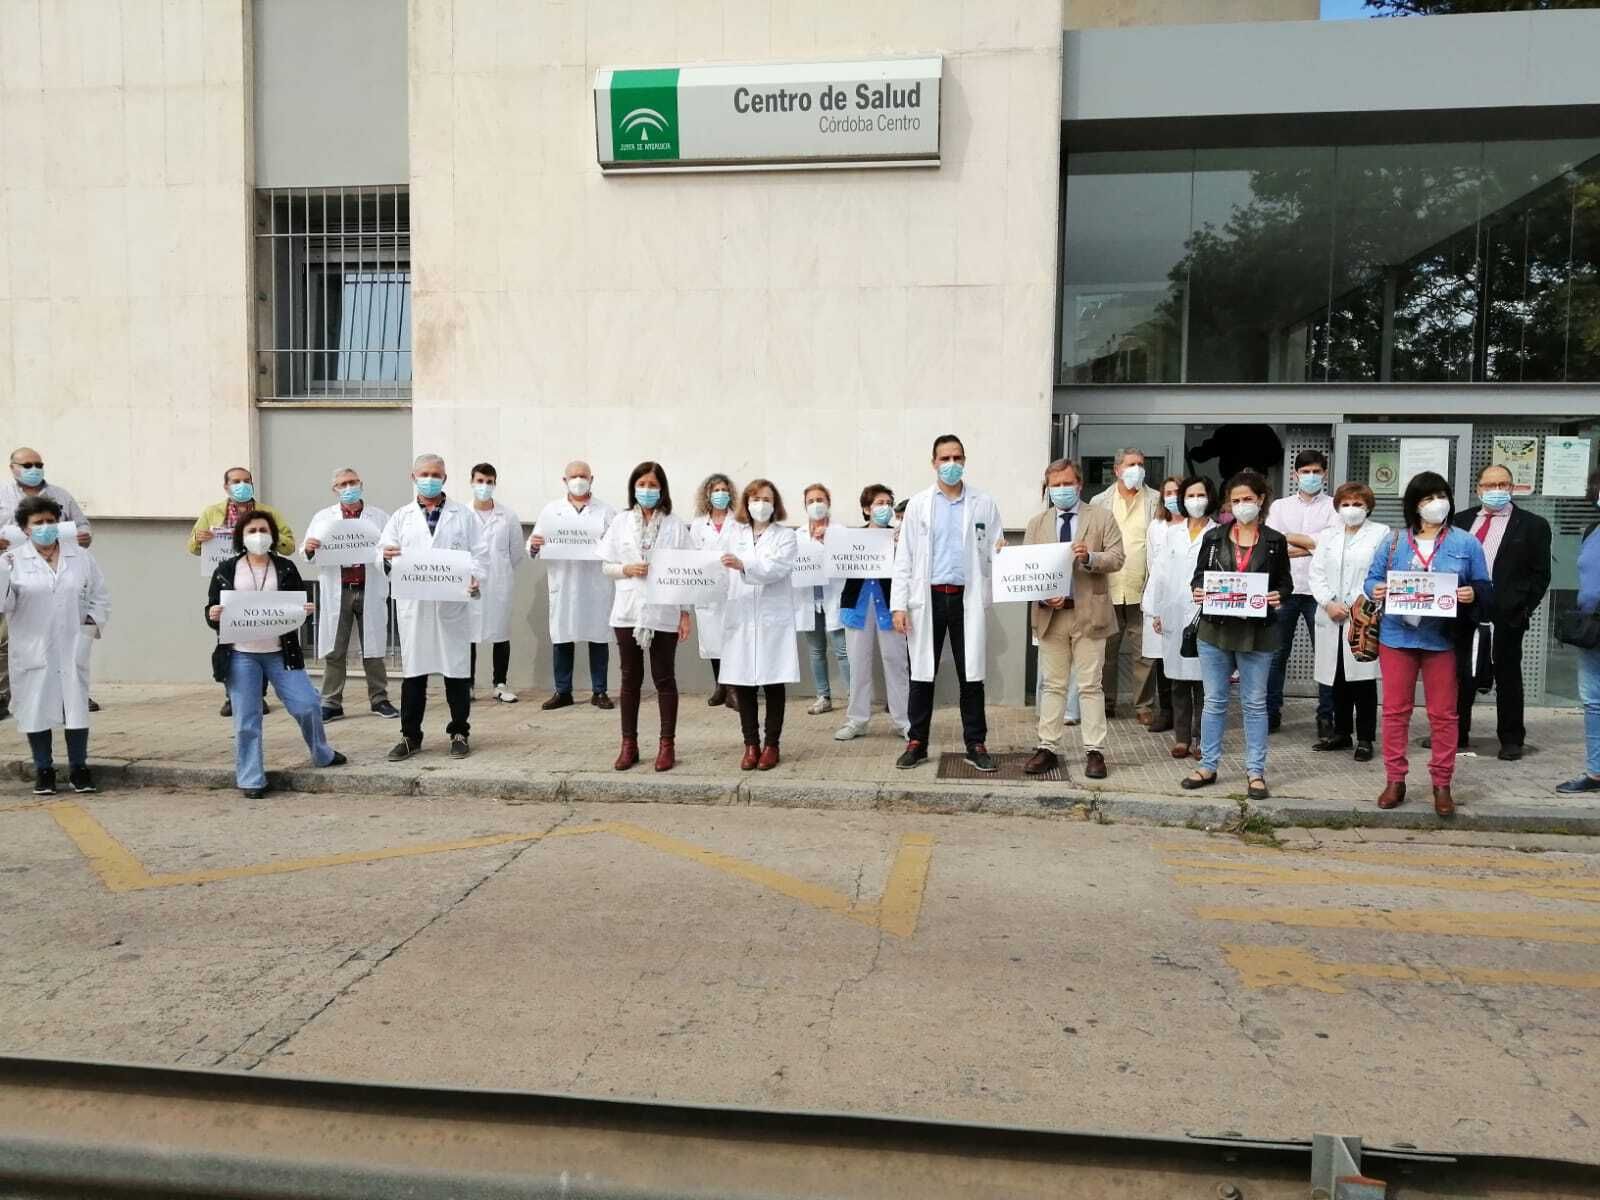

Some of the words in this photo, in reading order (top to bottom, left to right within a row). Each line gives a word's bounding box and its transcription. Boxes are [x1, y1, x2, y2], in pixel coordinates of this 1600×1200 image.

[733, 87, 812, 114] Centro
[819, 84, 847, 111] de
[855, 81, 921, 110] Salud
[819, 115, 873, 134] Córdoba
[877, 113, 921, 132] Centro
[636, 143, 644, 151] DE
[345, 532, 365, 541] MAS
[557, 528, 569, 536] NO
[547, 537, 598, 545] AGRESIONES
[321, 541, 377, 551] AGRESIONES
[852, 544, 865, 552] NO
[830, 553, 886, 562] AGRESIONES
[413, 563, 428, 572] NO
[429, 563, 451, 573] MAS
[836, 563, 881, 571] VERBALES
[1024, 562, 1039, 570] NO
[667, 567, 680, 575] NO
[681, 567, 703, 576] MAS
[400, 574, 464, 584] AGRESIONES
[656, 577, 716, 586] AGRESIONES
[1001, 571, 1064, 583] AGRESIONES
[1006, 582, 1058, 593] VERBALES
[243, 607, 259, 617] NO
[261, 607, 285, 617] MAS
[230, 618, 297, 628] AGRESIONES
